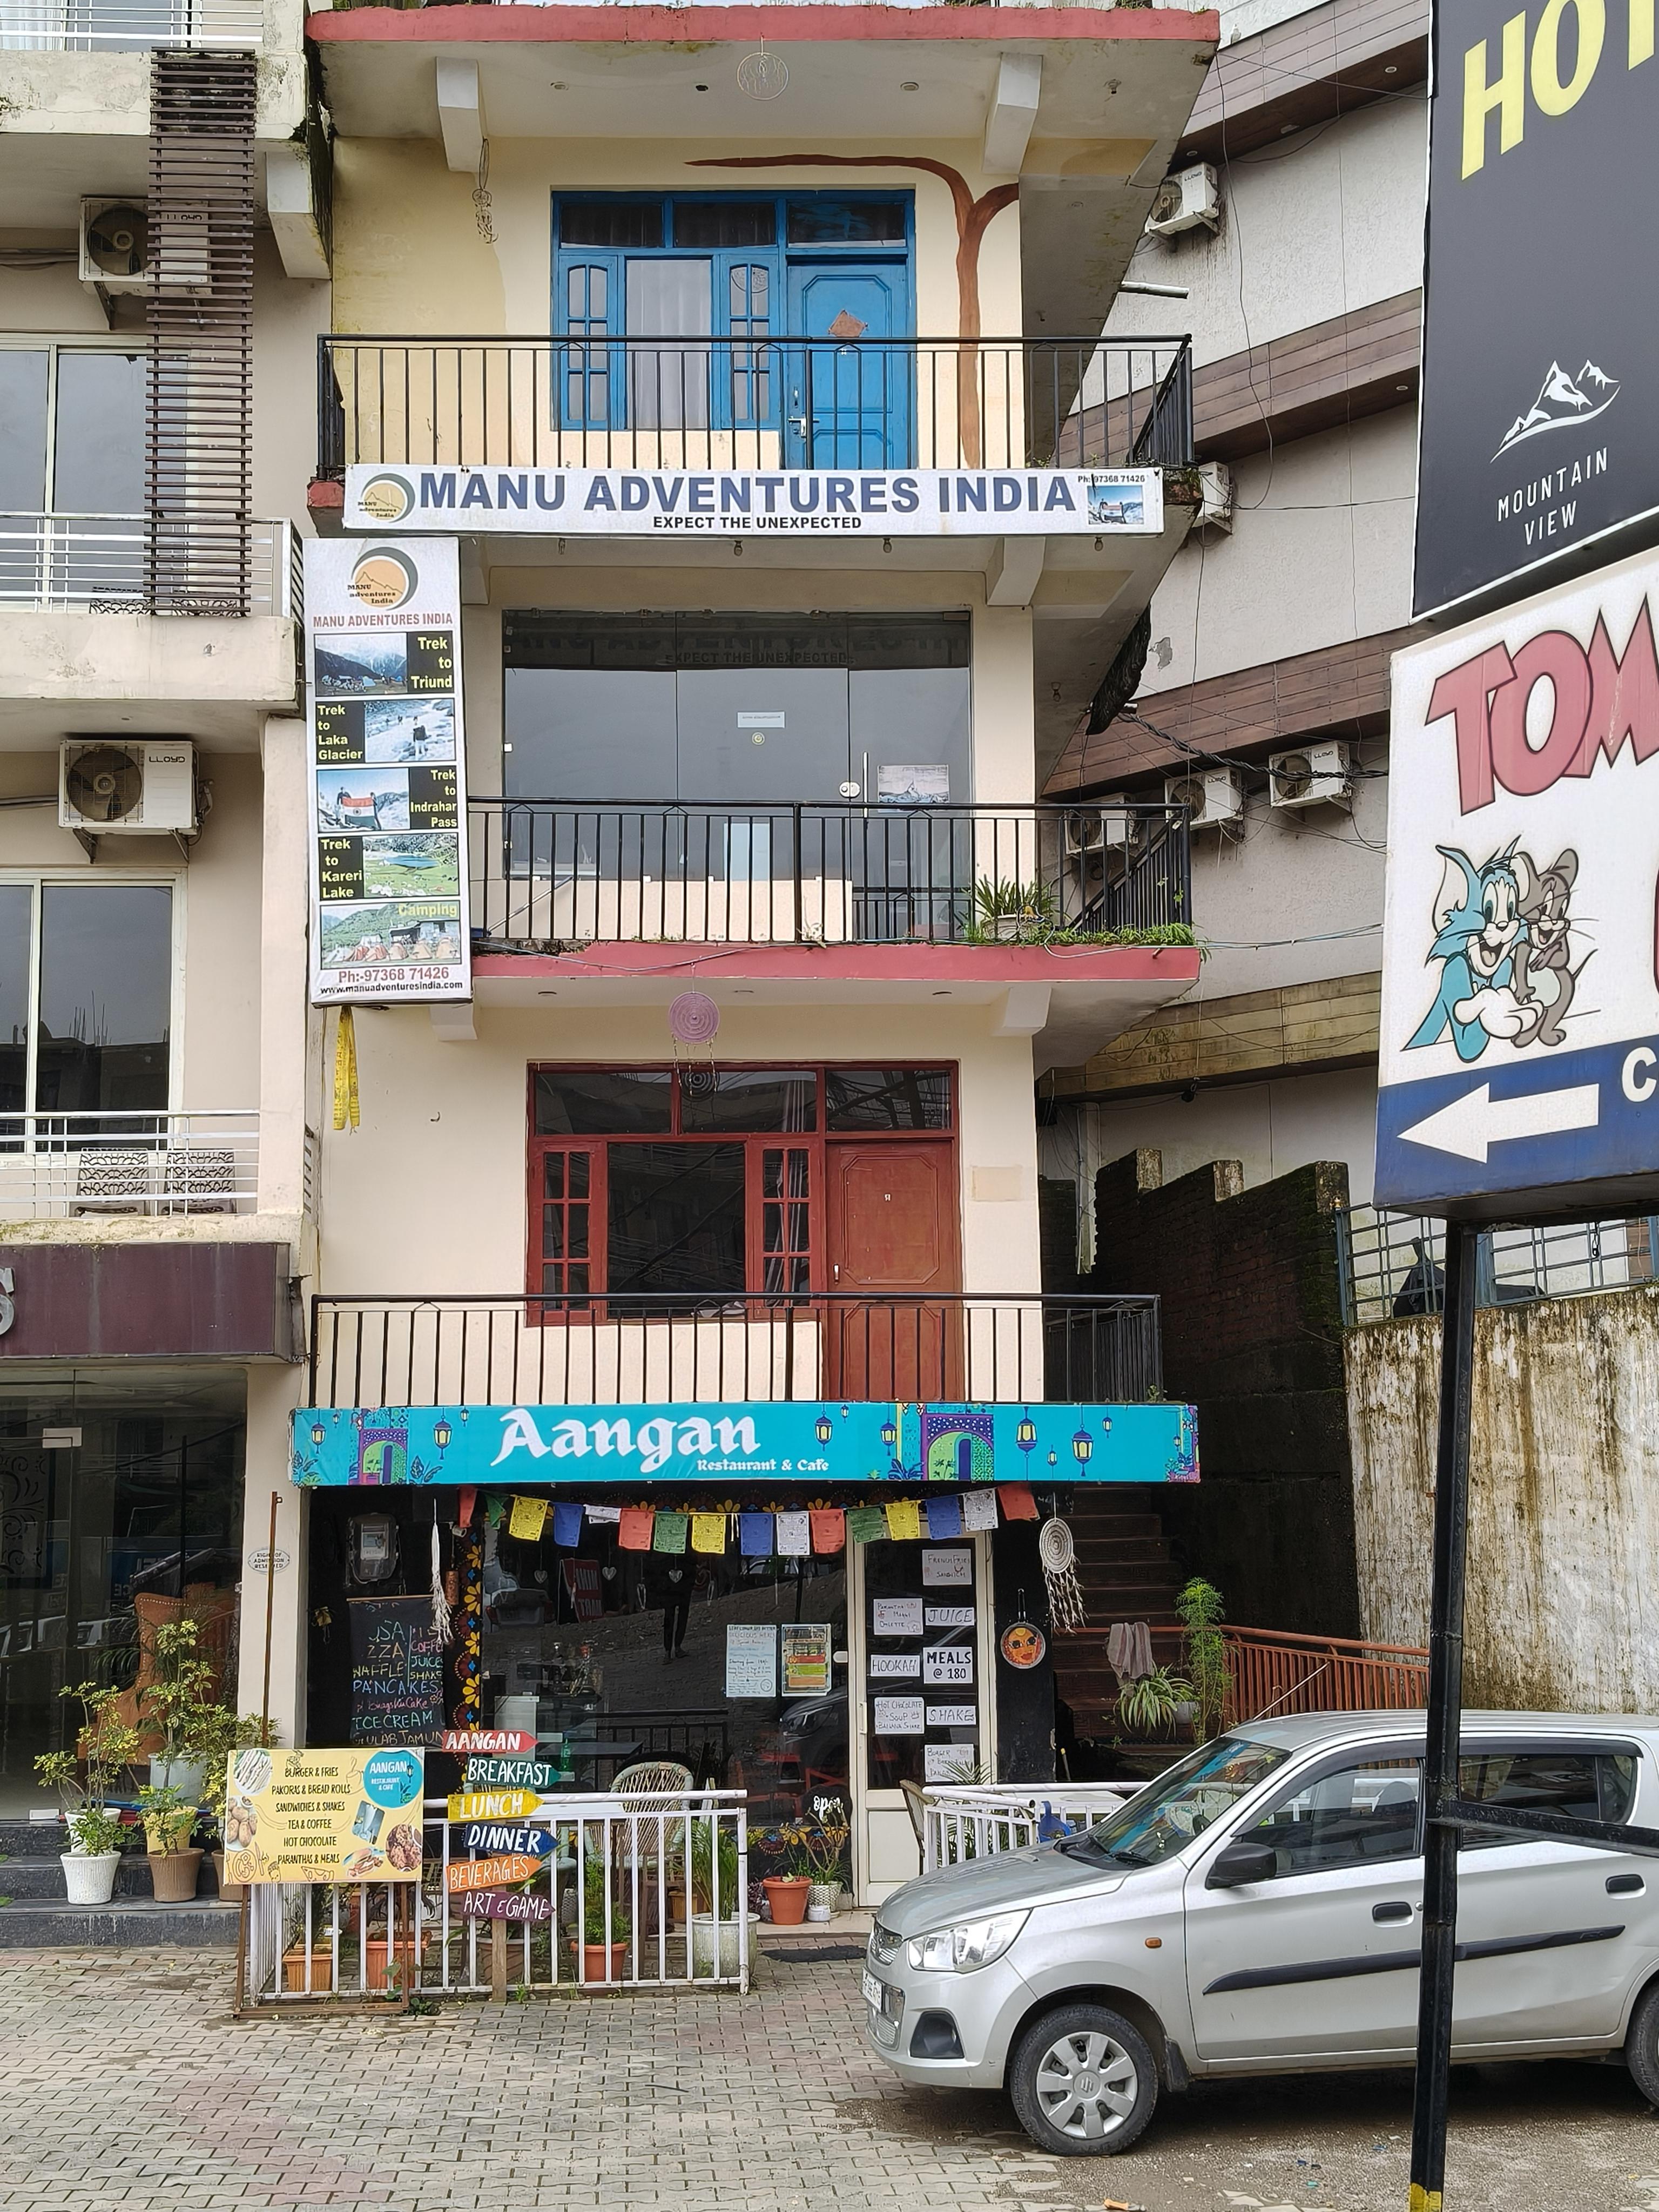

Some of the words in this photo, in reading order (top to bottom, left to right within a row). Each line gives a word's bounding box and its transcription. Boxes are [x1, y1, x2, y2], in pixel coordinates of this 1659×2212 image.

[1498, 447, 1608, 522] MOUNTAIN
[420, 473, 565, 510] MANU
[583, 475, 919, 512] ADVENTURES
[940, 477, 1076, 512] INDIA
[653, 517, 714, 528] EXPECT
[720, 517, 751, 528] THE
[756, 517, 861, 529] UNEXPECTED
[1525, 500, 1576, 545] VIEW
[313, 616, 345, 628] MANU
[348, 613, 420, 626] ADVENTURES
[423, 613, 453, 625] INDIA
[417, 637, 448, 650] Trek
[439, 657, 452, 669] to
[411, 676, 453, 689] Triund
[318, 705, 346, 716] Trek
[1424, 592, 1659, 817] TOM
[318, 721, 330, 730] to
[318, 735, 348, 745] Laka
[318, 748, 363, 760] Glacier
[430, 769, 455, 780] Trek
[444, 785, 456, 795] to
[410, 801, 457, 813] Indrahar
[431, 817, 457, 828] Pass
[320, 839, 351, 850] Trek
[325, 855, 339, 866] to
[322, 870, 362, 882] Kareri
[322, 886, 354, 899] Lake
[397, 902, 457, 917] Camping
[409, 967, 449, 980] 71426
[320, 981, 463, 994] www.manuadventuresindia.com
[490, 1407, 761, 1473] Aangan
[697, 1459, 776, 1472] Restaurant
[781, 1460, 792, 1471] &
[797, 1458, 830, 1471] Cafe
[928, 1609, 973, 1622] JUICE
[927, 1651, 971, 1664] MEALS
[873, 1660, 916, 1672] HOOKAH
[933, 1668, 942, 1678] @
[947, 1668, 966, 1679] 180
[353, 1679, 439, 1695] PANCAKES
[929, 1709, 975, 1722] SHAKE
[446, 1732, 521, 1751] AANGAN
[285, 1766, 313, 1777] BURGER
[315, 1768, 320, 1776] &
[321, 1767, 339, 1777] FRIES
[370, 1761, 407, 1773] AANGAN
[468, 1758, 551, 1786] BREAKFAST
[272, 1785, 300, 1795] PAKORAS
[302, 1785, 306, 1794] &
[308, 1784, 329, 1794] BREAD
[331, 1784, 351, 1794] ROLLS
[316, 1802, 321, 1811] &
[322, 1802, 345, 1811] SHAKES
[460, 1793, 524, 1818] LUNCH
[288, 1820, 299, 1830] TEA
[300, 1820, 305, 1829] &
[307, 1819, 332, 1829] COFFEE
[284, 1837, 298, 1847] HOT
[300, 1836, 337, 1846] CHOCOLATE
[468, 1825, 542, 1853] DINNER
[278, 1854, 313, 1865] PARANTHAS
[314, 1854, 319, 1864] &
[321, 1853, 340, 1864] MEALS
[449, 1856, 529, 1890] BEVERAGES
[463, 1891, 495, 1914] ART
